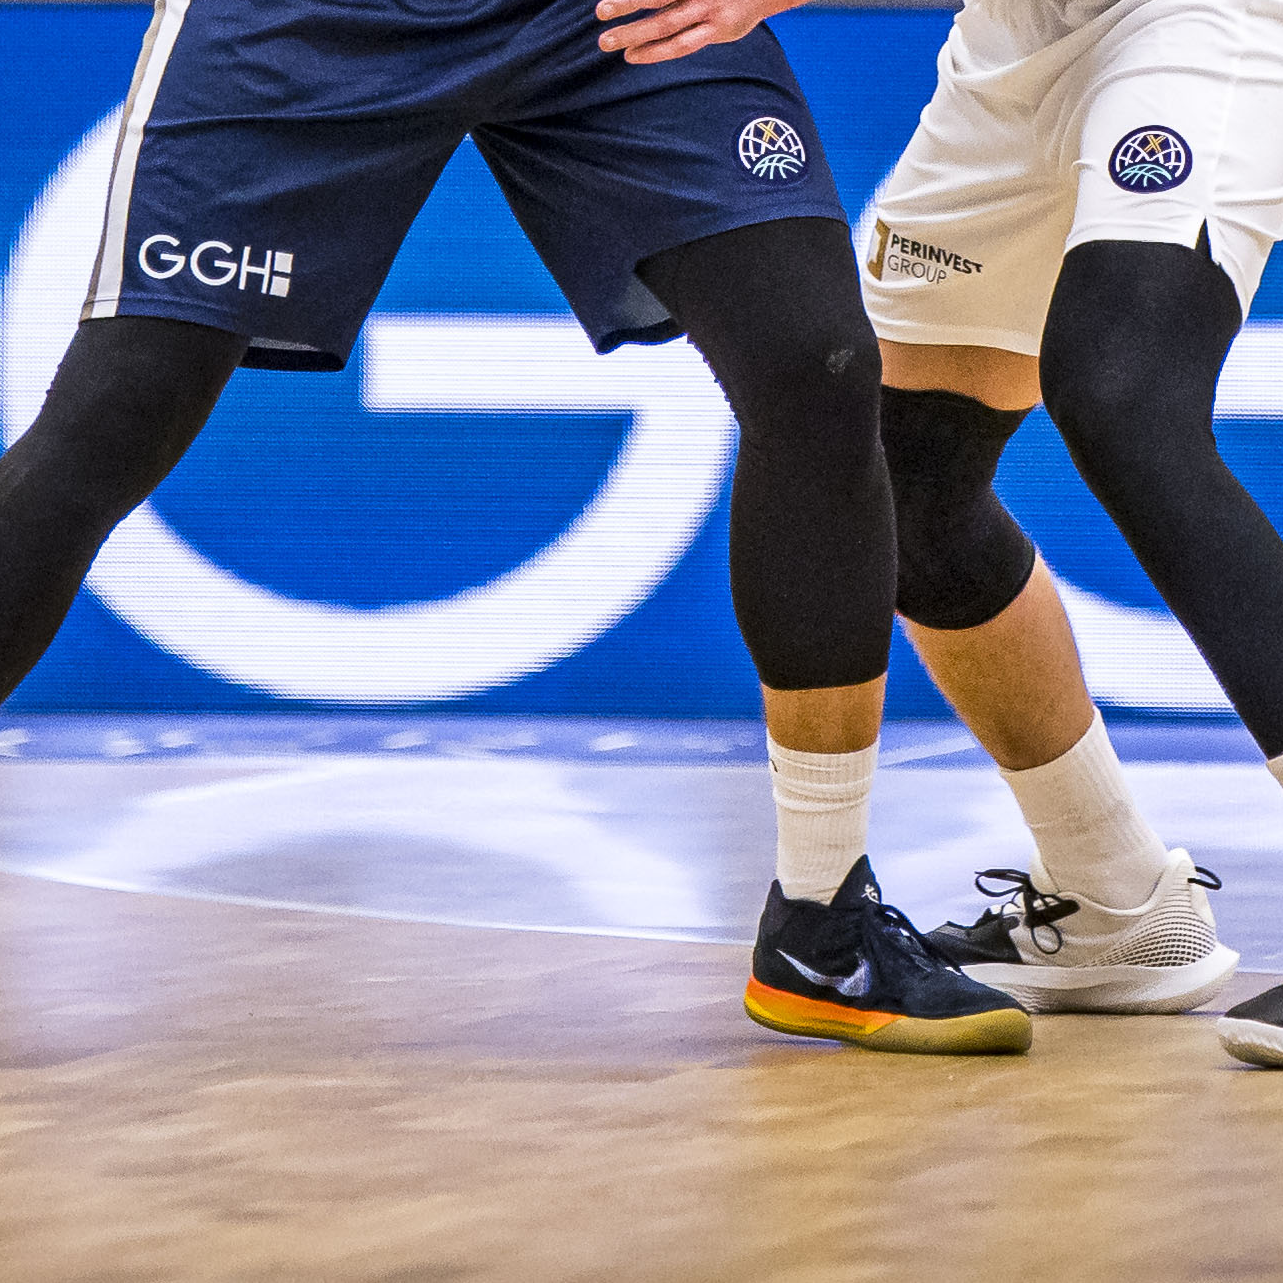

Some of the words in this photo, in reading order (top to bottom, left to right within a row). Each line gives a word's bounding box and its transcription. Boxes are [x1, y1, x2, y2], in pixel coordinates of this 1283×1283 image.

[138, 234, 273, 294] GGH
[887, 254, 947, 284] GROUP
[890, 233, 983, 274] PERINVEST
